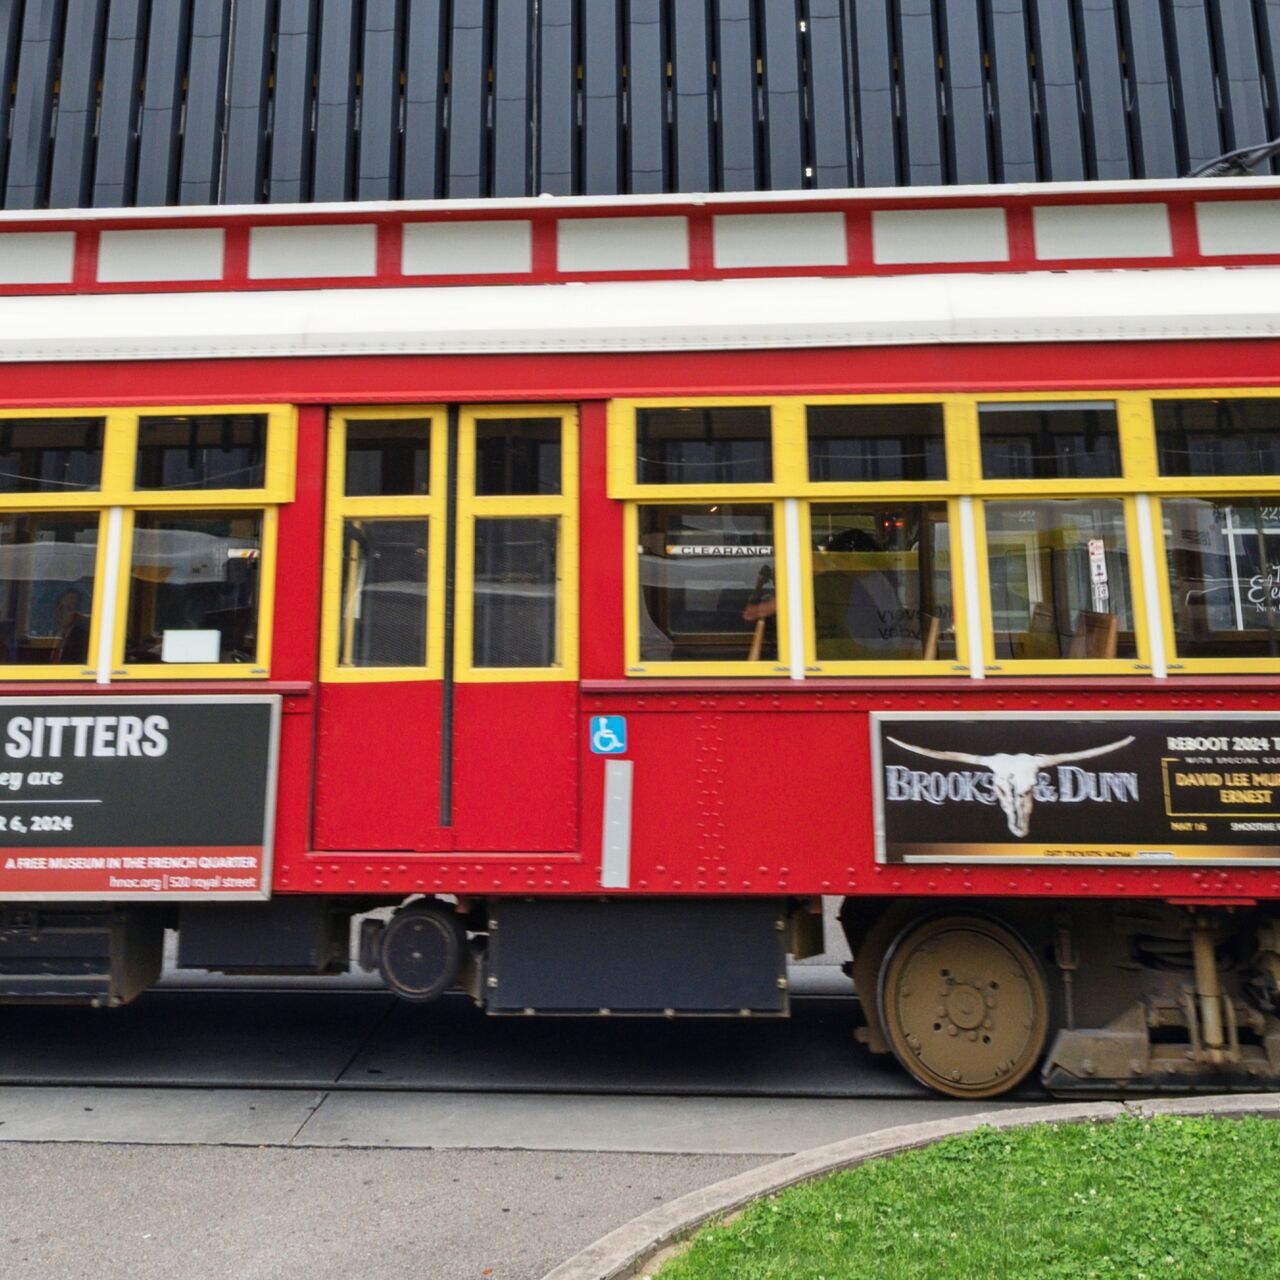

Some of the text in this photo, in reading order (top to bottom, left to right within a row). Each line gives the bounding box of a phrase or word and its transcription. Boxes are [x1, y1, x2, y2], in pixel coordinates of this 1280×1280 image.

[5, 715, 169, 758] SITTERS
[1167, 736, 1230, 751] REBOOT
[1232, 737, 1271, 751] 2024
[27, 771, 64, 786] are
[885, 765, 1139, 805] BROOKS & DUNN
[1175, 773, 1223, 786] DAVID
[1224, 773, 1250, 786] LEE
[1219, 790, 1273, 803] ERNEST
[10, 816, 27, 834] 6,
[30, 815, 73, 832] 2024
[4, 857, 257, 869] A FREE MUSEUM IN THE FRENCH QUARTER
[221, 876, 257, 888] street
